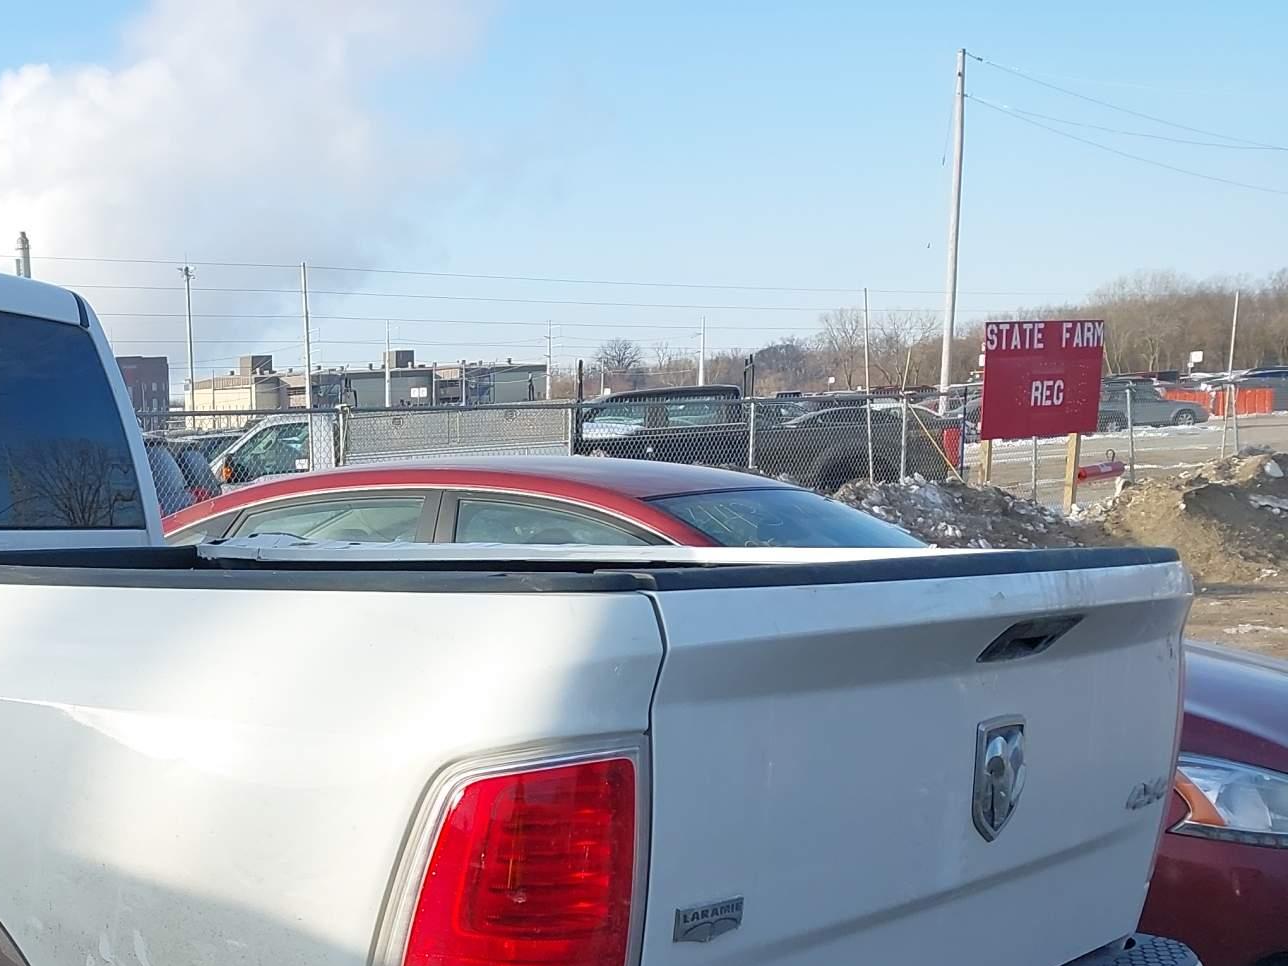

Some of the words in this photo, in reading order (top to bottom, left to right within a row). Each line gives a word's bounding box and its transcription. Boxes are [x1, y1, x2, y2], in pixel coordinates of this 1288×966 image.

[986, 322, 1045, 350] STATE
[1062, 321, 1105, 348] FARM
[1030, 379, 1065, 407] REG
[682, 901, 744, 924] LARAMIE
